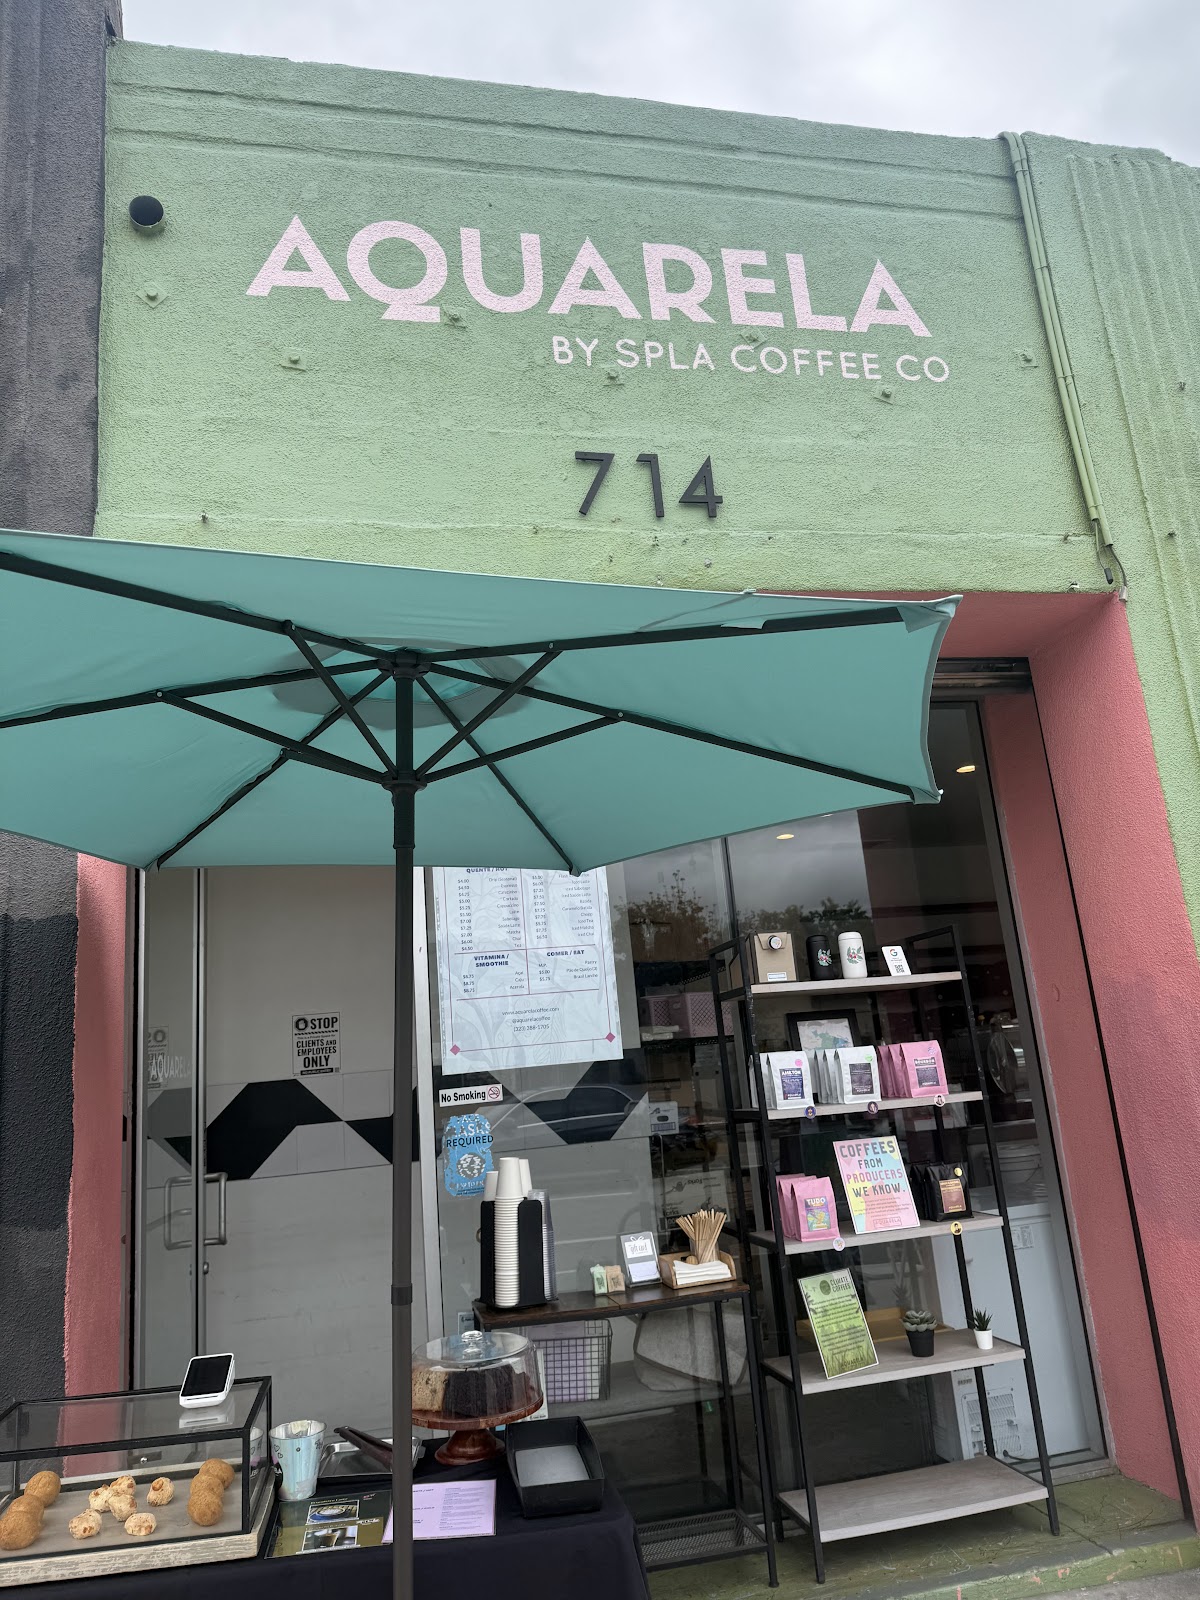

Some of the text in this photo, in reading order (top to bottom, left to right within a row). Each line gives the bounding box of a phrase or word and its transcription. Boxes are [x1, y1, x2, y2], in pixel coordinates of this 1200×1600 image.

[245, 213, 932, 337] AQUARELA
[551, 335, 950, 384] BY SPLA COFFEE CO
[574, 450, 723, 518] 714
[474, 954, 505, 962] VITAMINA
[475, 960, 509, 968] SMOOTHIE
[310, 1016, 339, 1030] STOP
[296, 1038, 325, 1049] CLIENTS
[297, 1046, 337, 1057] EMPLOYEES
[303, 1054, 331, 1069] ONLY
[441, 1090, 486, 1103] No Smoking
[446, 1135, 494, 1148] REQUIRED
[839, 1140, 896, 1158] COFFEES
[857, 1158, 884, 1170] FROM
[845, 1168, 904, 1185] PRODUCERS
[852, 1182, 906, 1198] WE KNOW.
[806, 1197, 827, 1206] TUDO
[829, 1275, 849, 1287] CLIMATE
[832, 1282, 852, 1293] COFFEES
